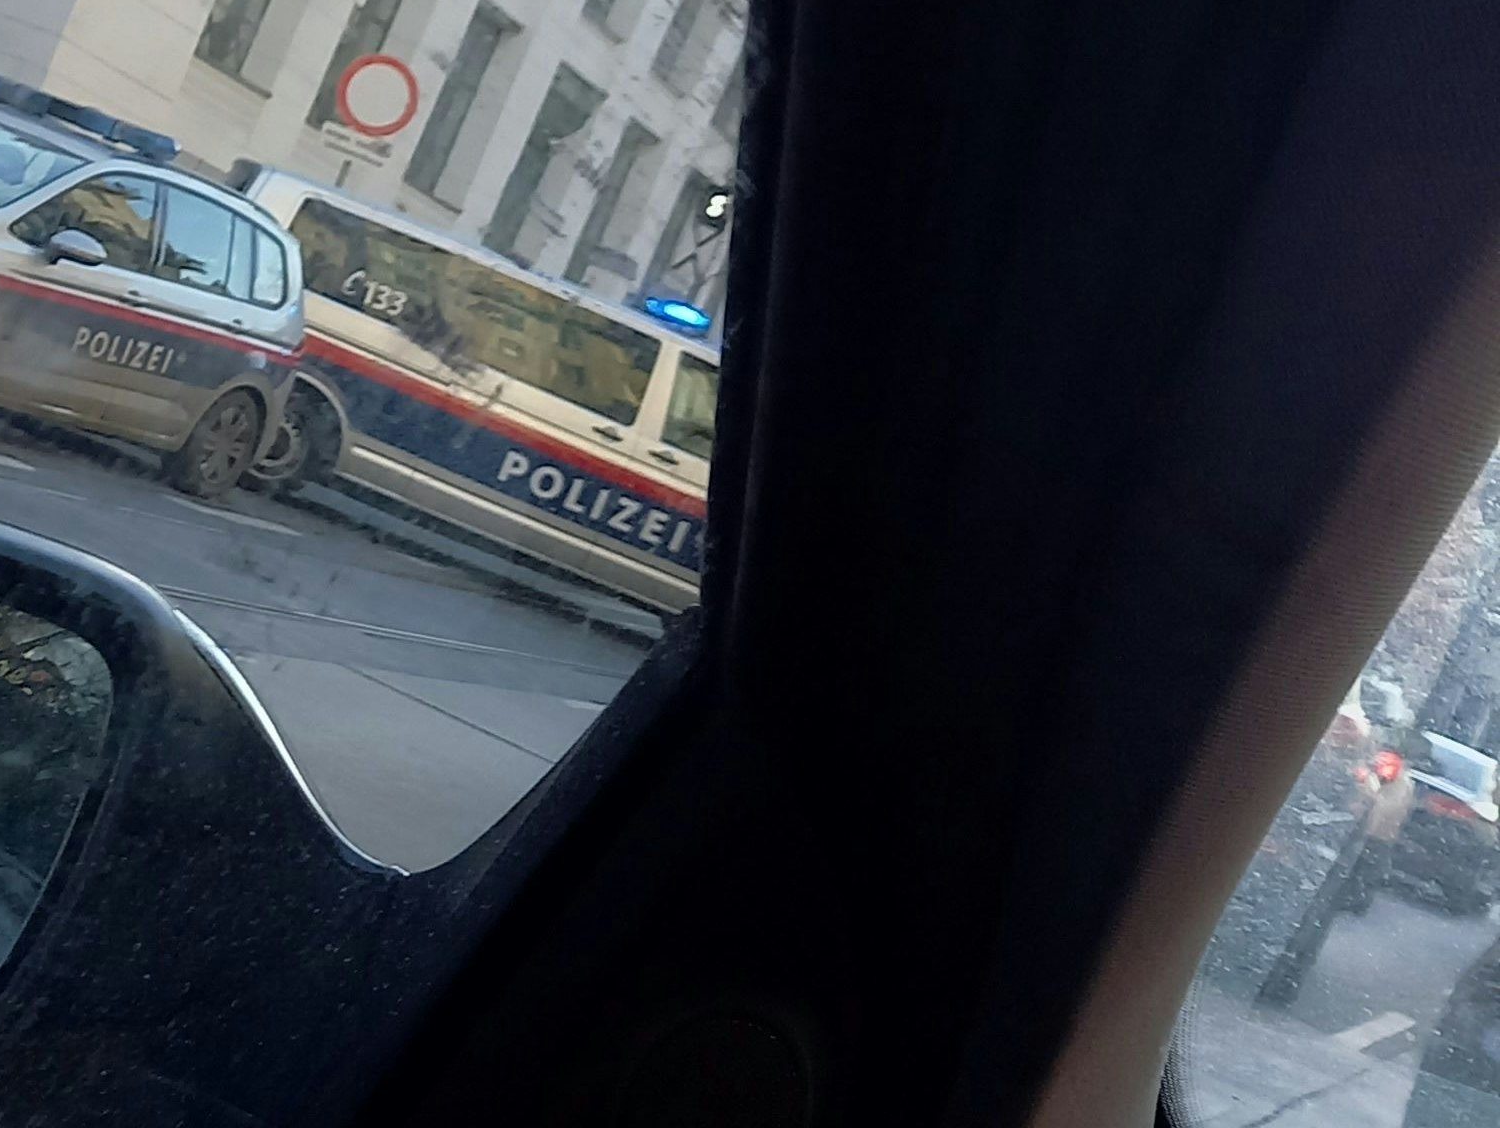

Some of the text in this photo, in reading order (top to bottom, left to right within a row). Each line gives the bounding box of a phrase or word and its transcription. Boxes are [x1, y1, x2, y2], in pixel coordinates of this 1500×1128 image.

[363, 281, 408, 316] 133
[71, 326, 175, 374] POLIZEI
[496, 449, 692, 553] POLIZEI
